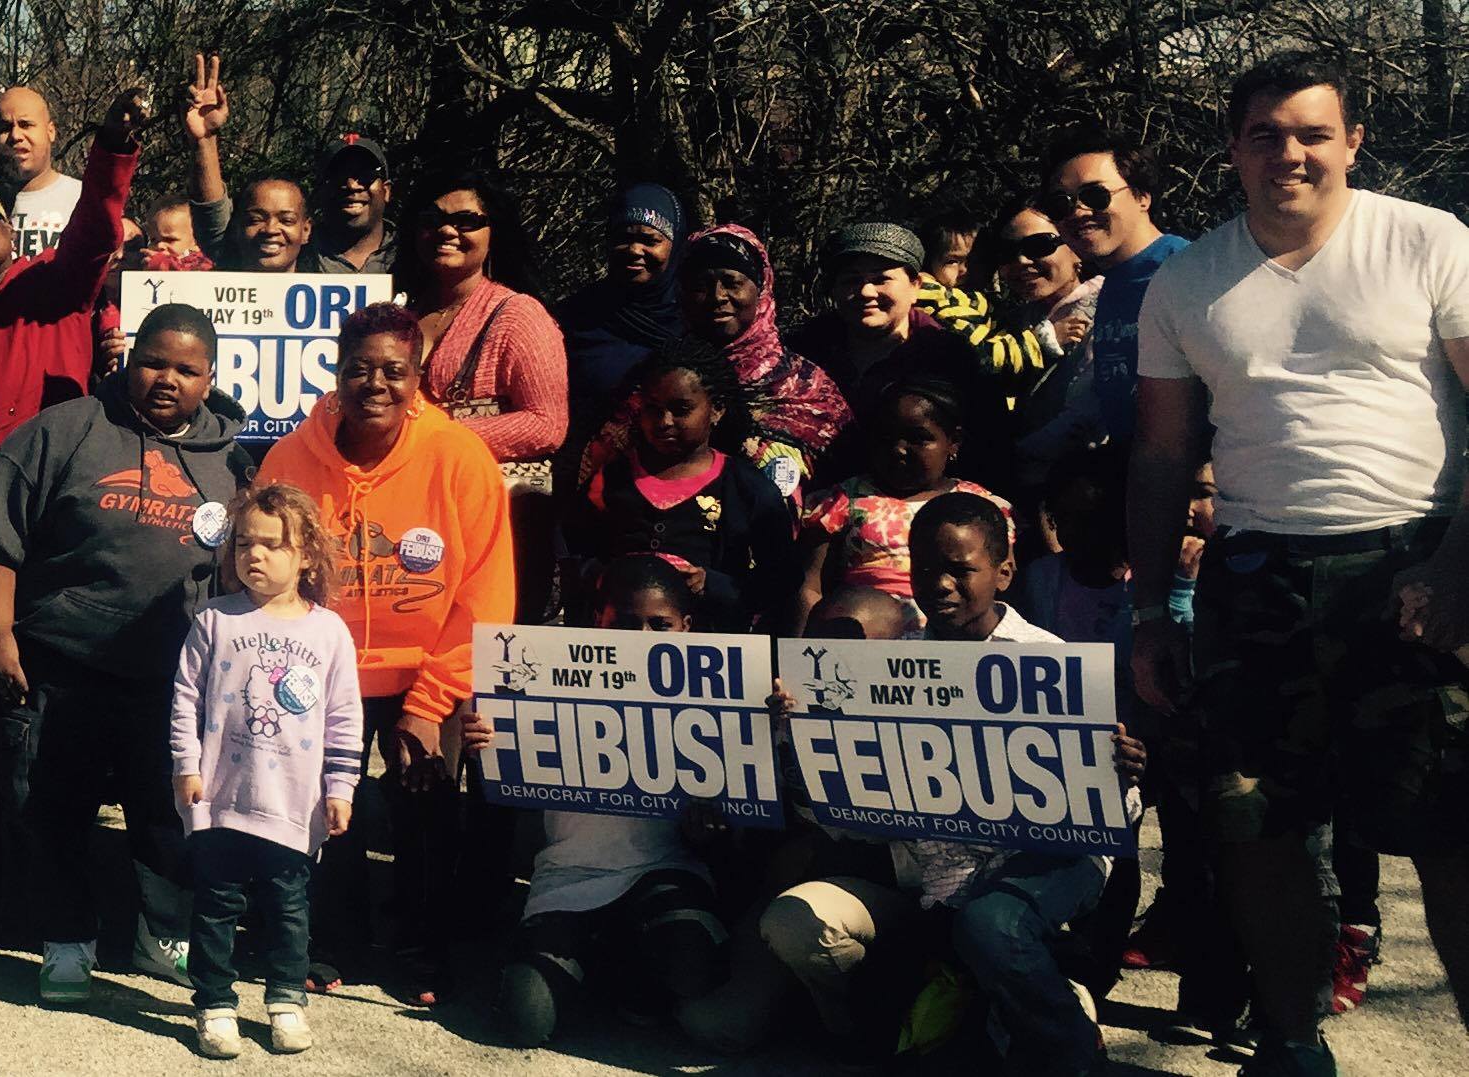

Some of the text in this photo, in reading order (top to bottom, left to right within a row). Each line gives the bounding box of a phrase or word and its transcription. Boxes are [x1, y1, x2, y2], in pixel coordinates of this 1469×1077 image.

[214, 286, 257, 303] VOTE
[242, 307, 273, 325] 19th
[231, 632, 323, 669] Hello Kitty
[568, 643, 617, 665] VOTE
[551, 668, 637, 690] MAY 19th
[647, 642, 745, 700] ORI
[887, 657, 942, 680] VOTE
[870, 684, 965, 708] MAY 19th
[975, 653, 1085, 717] ORI
[476, 697, 778, 802] FEIBUSH
[789, 718, 1128, 829] FEIBUSH
[500, 784, 592, 805] DEMOCRAT
[599, 792, 636, 808] FOR
[640, 795, 680, 811] CITY
[829, 805, 1122, 847] DEMOCRAT FOR CITY COUNCIL
